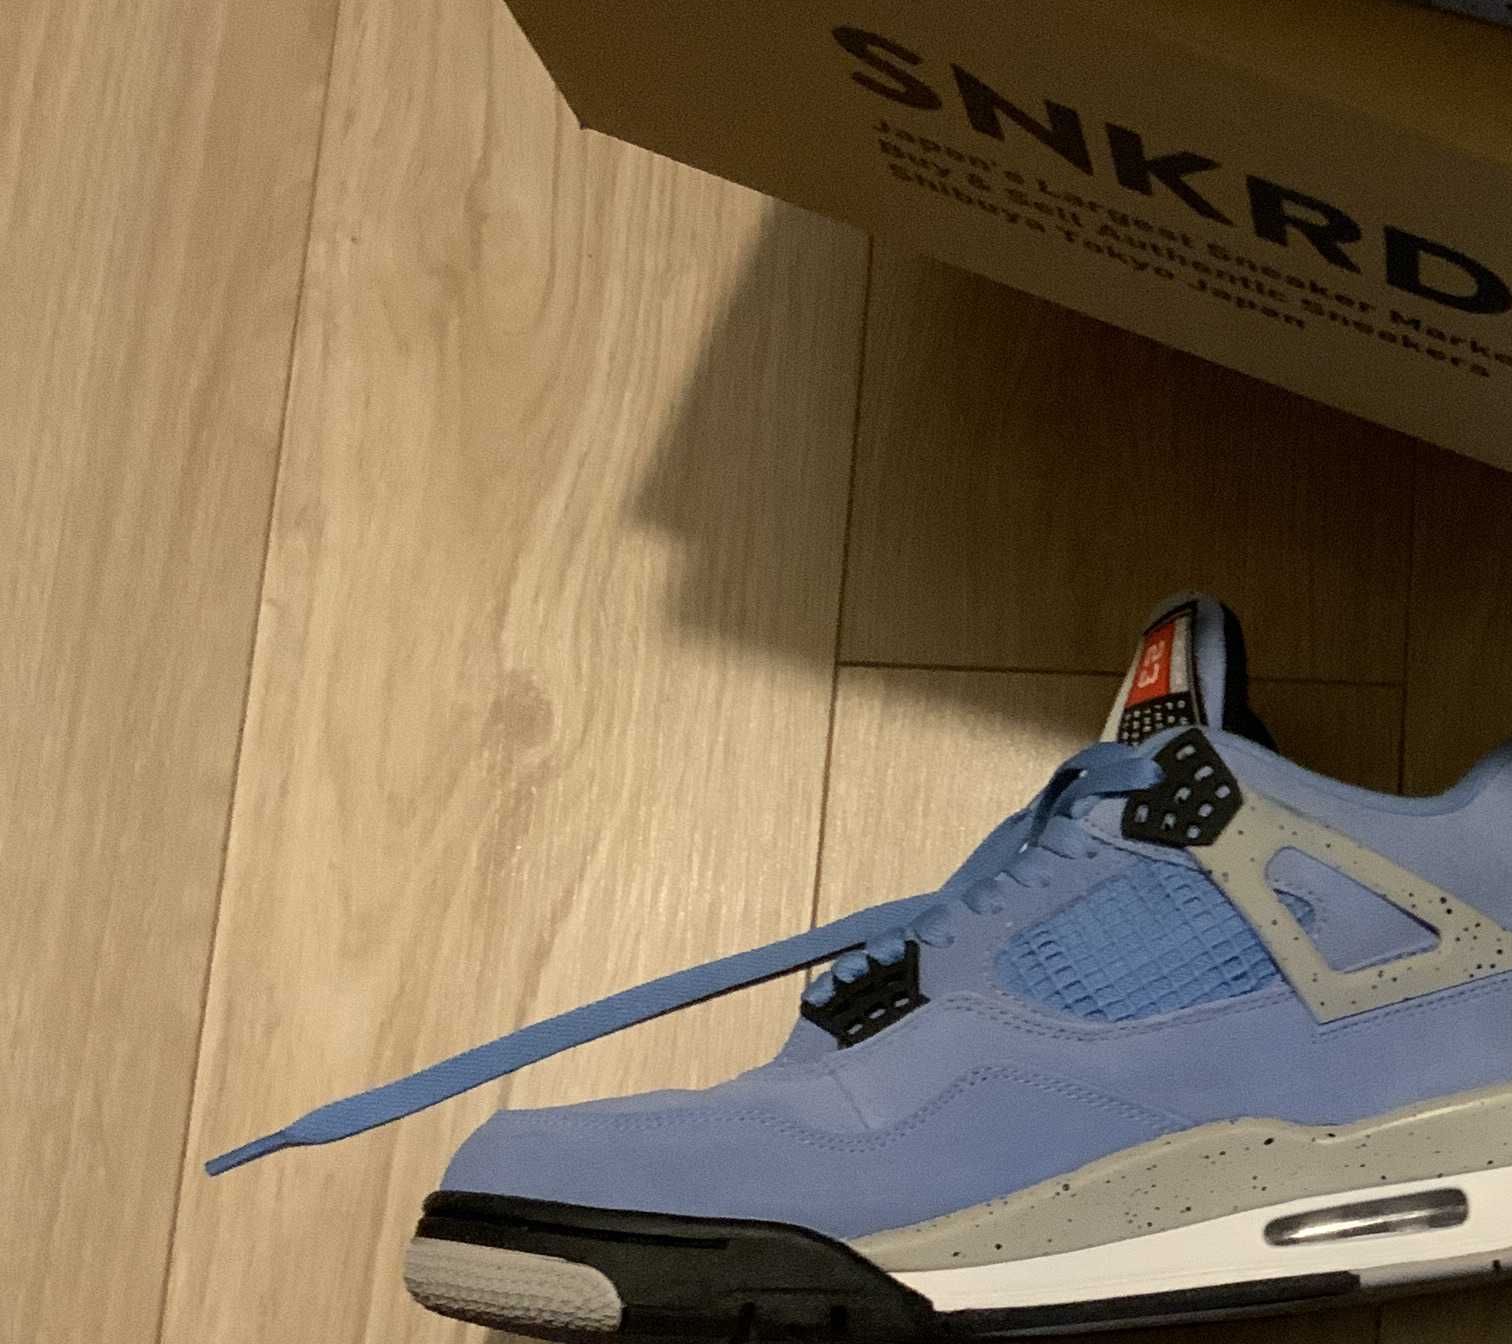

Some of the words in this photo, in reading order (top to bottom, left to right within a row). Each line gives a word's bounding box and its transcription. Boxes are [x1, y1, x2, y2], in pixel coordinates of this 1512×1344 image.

[872, 118, 1025, 186] Japan's
[1038, 178, 1196, 248] Largest
[1206, 242, 1376, 313] Sneaker
[888, 161, 1047, 234] Shibuya
[1056, 224, 1175, 283] Tokyo
[1187, 276, 1307, 330] Japan
[1004, 186, 1085, 229] Sell
[1097, 221, 1289, 304] Authentic
[1300, 297, 1493, 379] Sneakers
